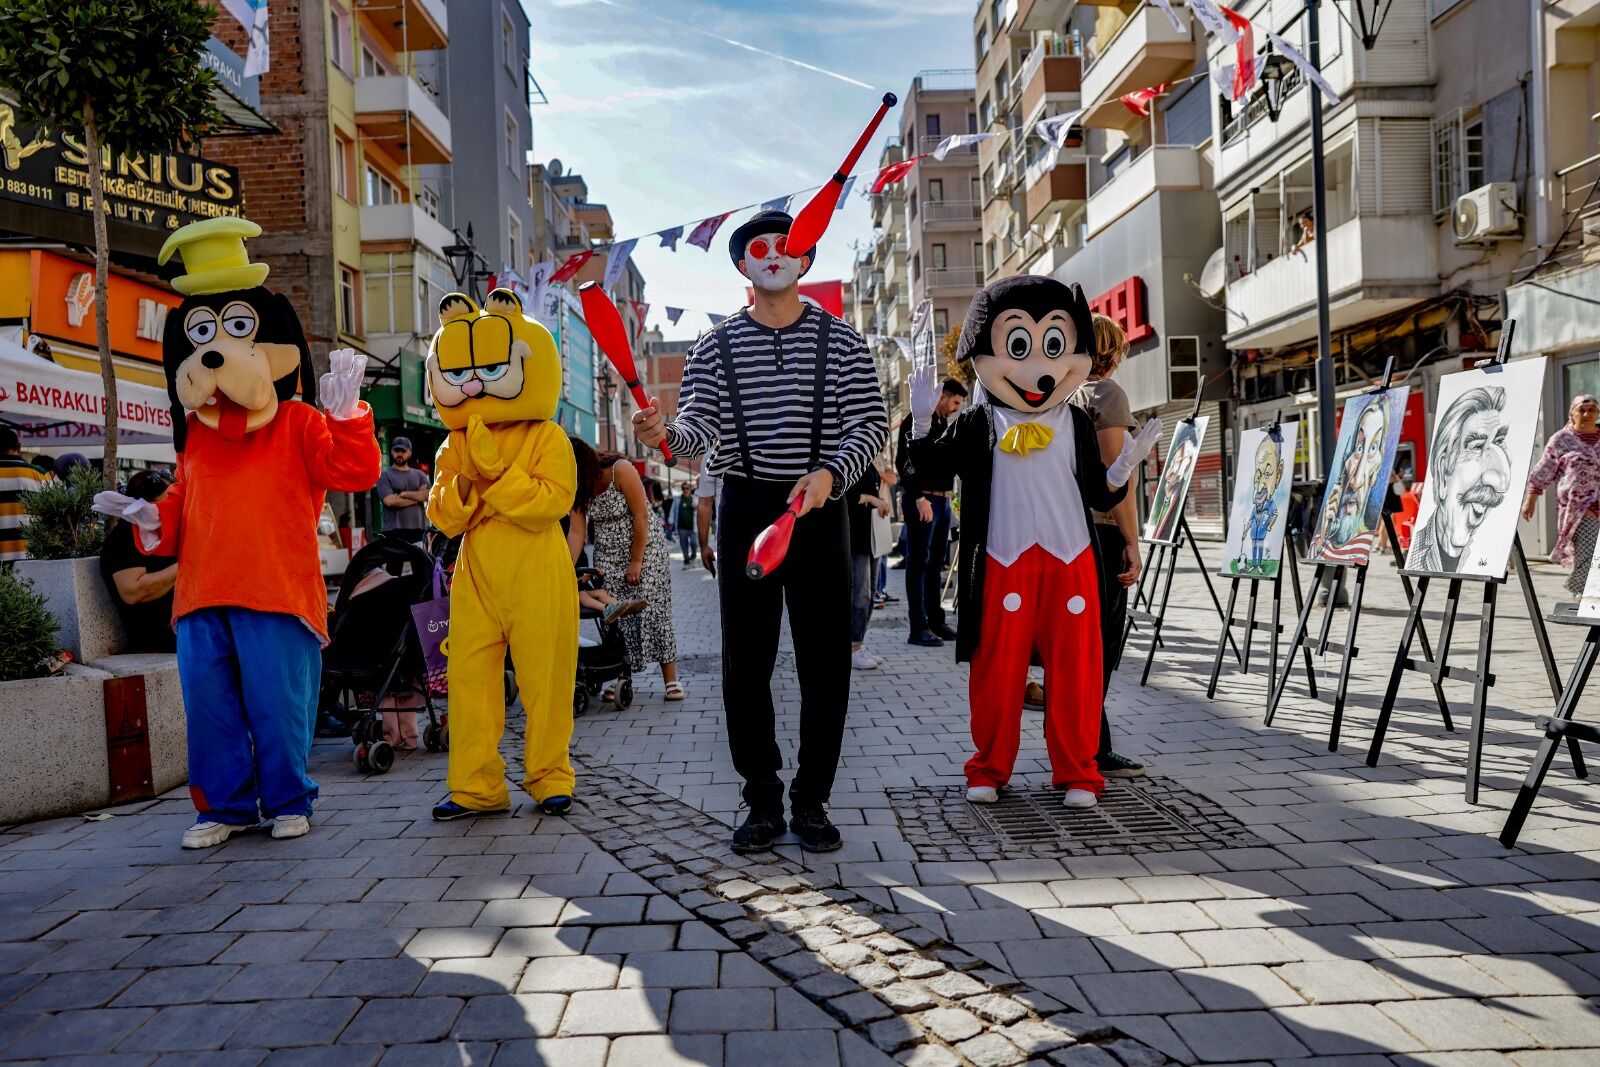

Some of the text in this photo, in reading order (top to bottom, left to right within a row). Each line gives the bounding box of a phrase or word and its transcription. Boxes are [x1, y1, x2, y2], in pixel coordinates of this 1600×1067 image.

[7, 179, 26, 195] 883
[28, 184, 53, 200] 9111
[55, 165, 187, 211] ESTEİK&GÜZELLİK
[16, 381, 97, 414] BAYRAKLI
